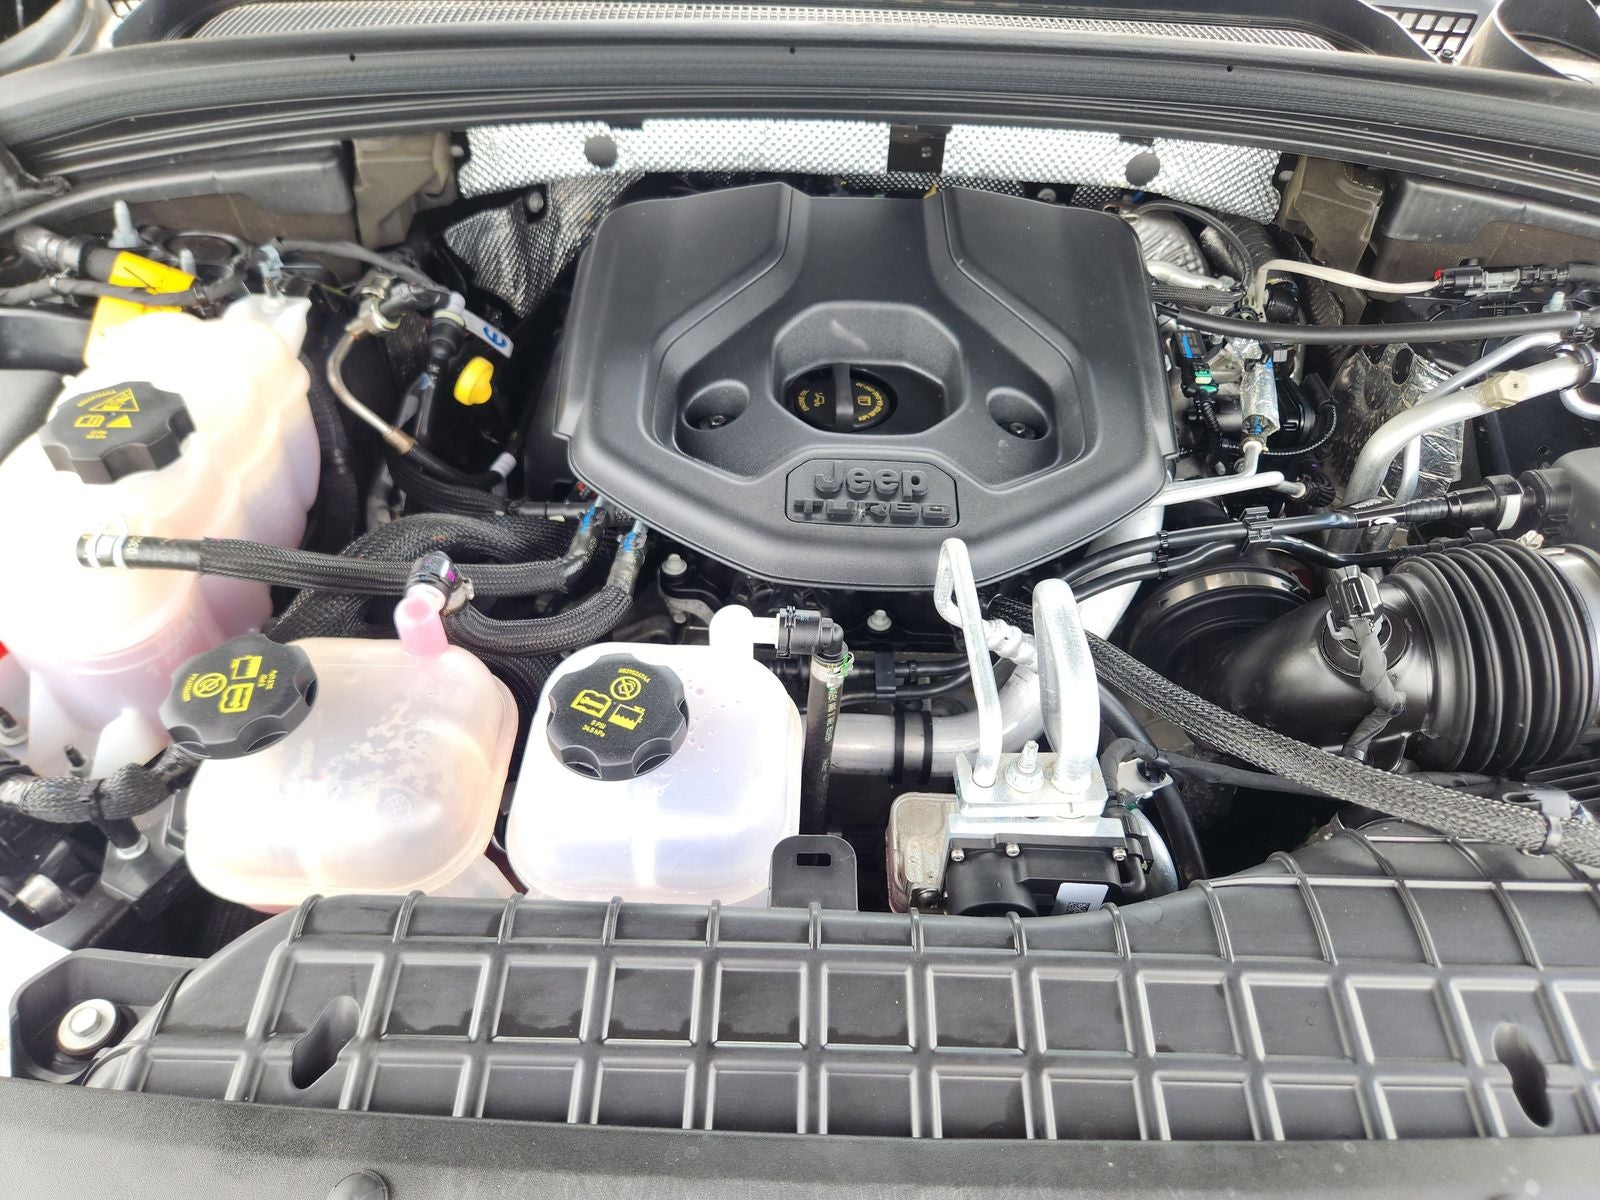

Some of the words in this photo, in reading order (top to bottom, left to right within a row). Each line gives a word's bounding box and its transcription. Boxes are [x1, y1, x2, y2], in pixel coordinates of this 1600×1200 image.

[814, 461, 929, 502] Jeep
[794, 498, 951, 518] TURBO
[596, 721, 607, 730] PSI
